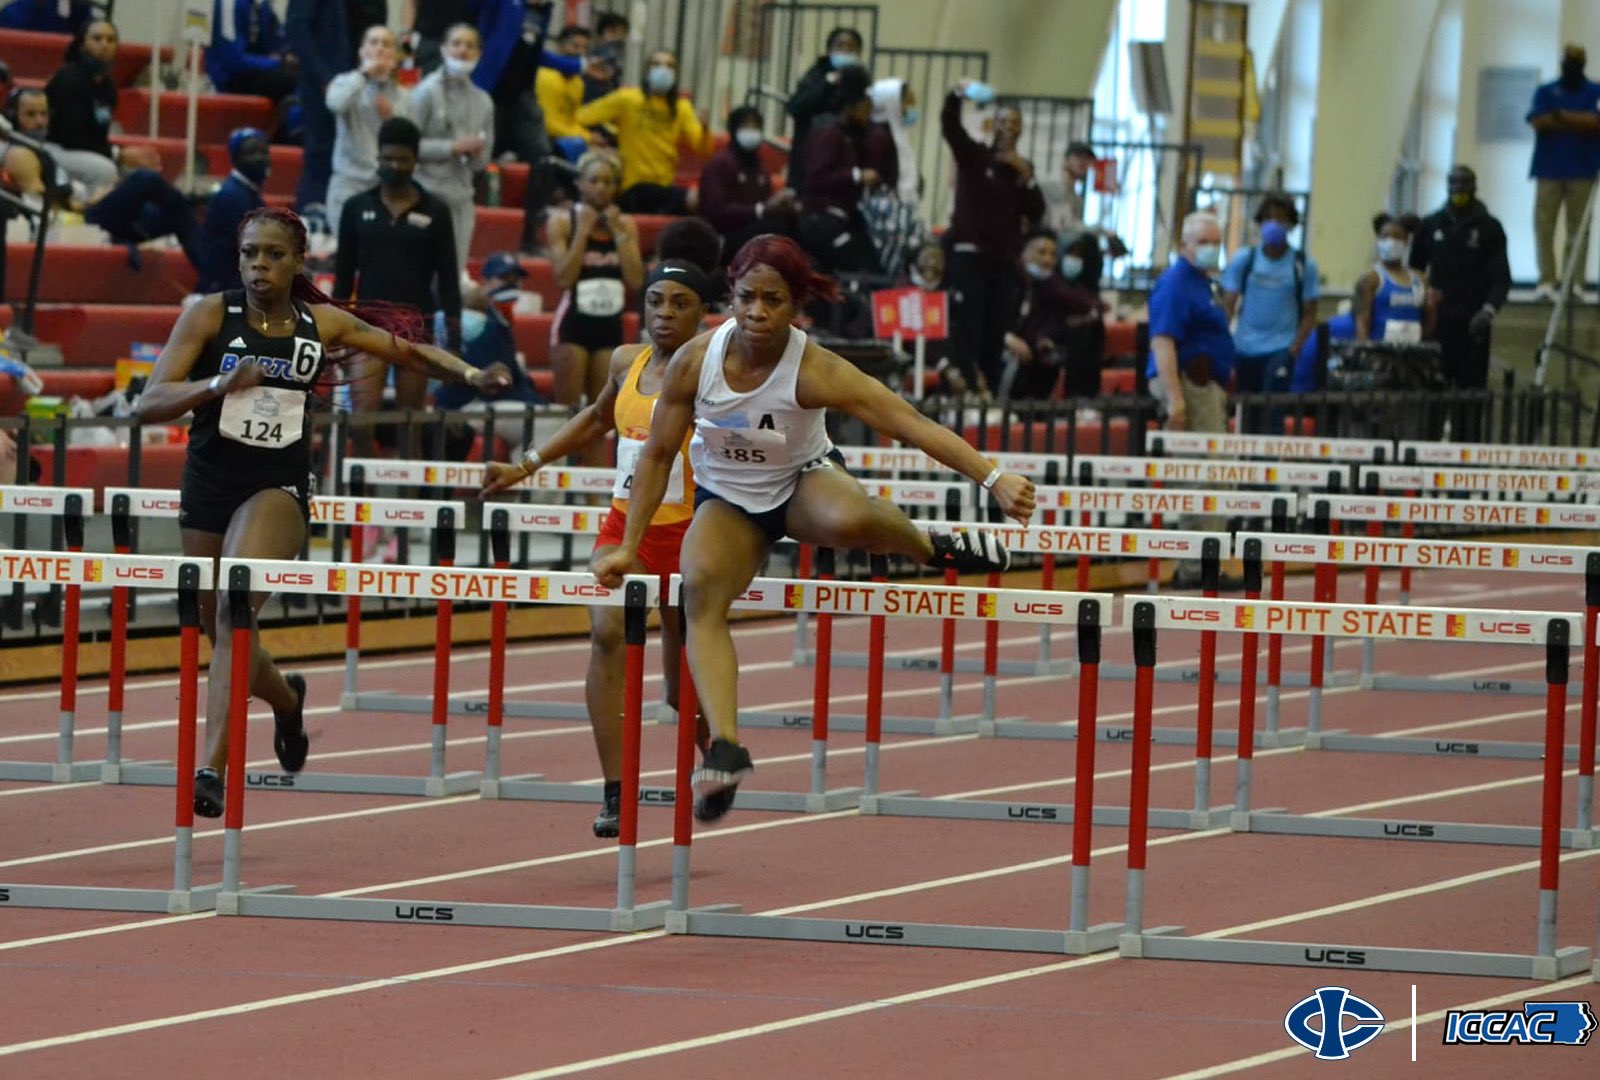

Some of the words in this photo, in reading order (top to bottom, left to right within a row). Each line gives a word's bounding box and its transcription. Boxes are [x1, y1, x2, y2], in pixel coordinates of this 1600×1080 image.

[296, 343, 317, 376] 6
[758, 413, 775, 430] A
[240, 419, 283, 443] 124
[1223, 439, 1260, 453] PITT
[1264, 441, 1313, 457] STATE
[880, 454, 918, 471] PITT
[1477, 448, 1514, 464] PITT
[1519, 450, 1569, 466] STATE
[1163, 463, 1203, 478] PITT
[1207, 465, 1257, 482] STATE
[1453, 472, 1490, 489] PITT
[1497, 474, 1549, 491] STATE
[13, 496, 53, 507] UCS
[1079, 491, 1125, 509] PITT
[1131, 494, 1195, 512] STATE
[1225, 499, 1262, 510] UCS
[309, 501, 345, 522] ATE
[385, 509, 425, 521] UCS
[521, 514, 561, 526] UCS
[1340, 503, 1377, 515] UCS
[1408, 503, 1457, 521] PITT
[1463, 506, 1527, 524] STATE
[1560, 513, 1596, 523] UCS
[1038, 530, 1111, 553] STATE
[1148, 539, 1190, 551] UCS
[1274, 543, 1316, 555] UCS
[1354, 541, 1408, 563] PITT
[1416, 544, 1493, 567] STATE
[1530, 553, 1574, 566] UCS
[0, 556, 71, 581] TATE
[116, 566, 165, 580] UCS
[265, 572, 314, 586] UCS
[358, 571, 421, 595] PITT
[430, 573, 518, 599] STATE
[562, 584, 611, 597] UCS
[815, 586, 876, 613] PITT
[883, 589, 966, 617] STATE
[1014, 601, 1064, 616] UCS
[1170, 609, 1220, 622] UCS
[1266, 607, 1331, 632] PITT
[1342, 611, 1433, 637] STATE
[1480, 621, 1532, 635] UCS
[902, 658, 939, 670] UCS
[1473, 680, 1512, 692] UCS
[464, 701, 489, 712] UC
[783, 716, 813, 727] UC
[1106, 729, 1133, 741] UC
[1436, 741, 1480, 754] UCS
[247, 773, 295, 787] UCS
[1008, 806, 1057, 820] UCS
[1383, 823, 1435, 837] UCS
[395, 905, 454, 921] UCS
[845, 924, 904, 939] UCS
[1305, 948, 1365, 965] UCS
